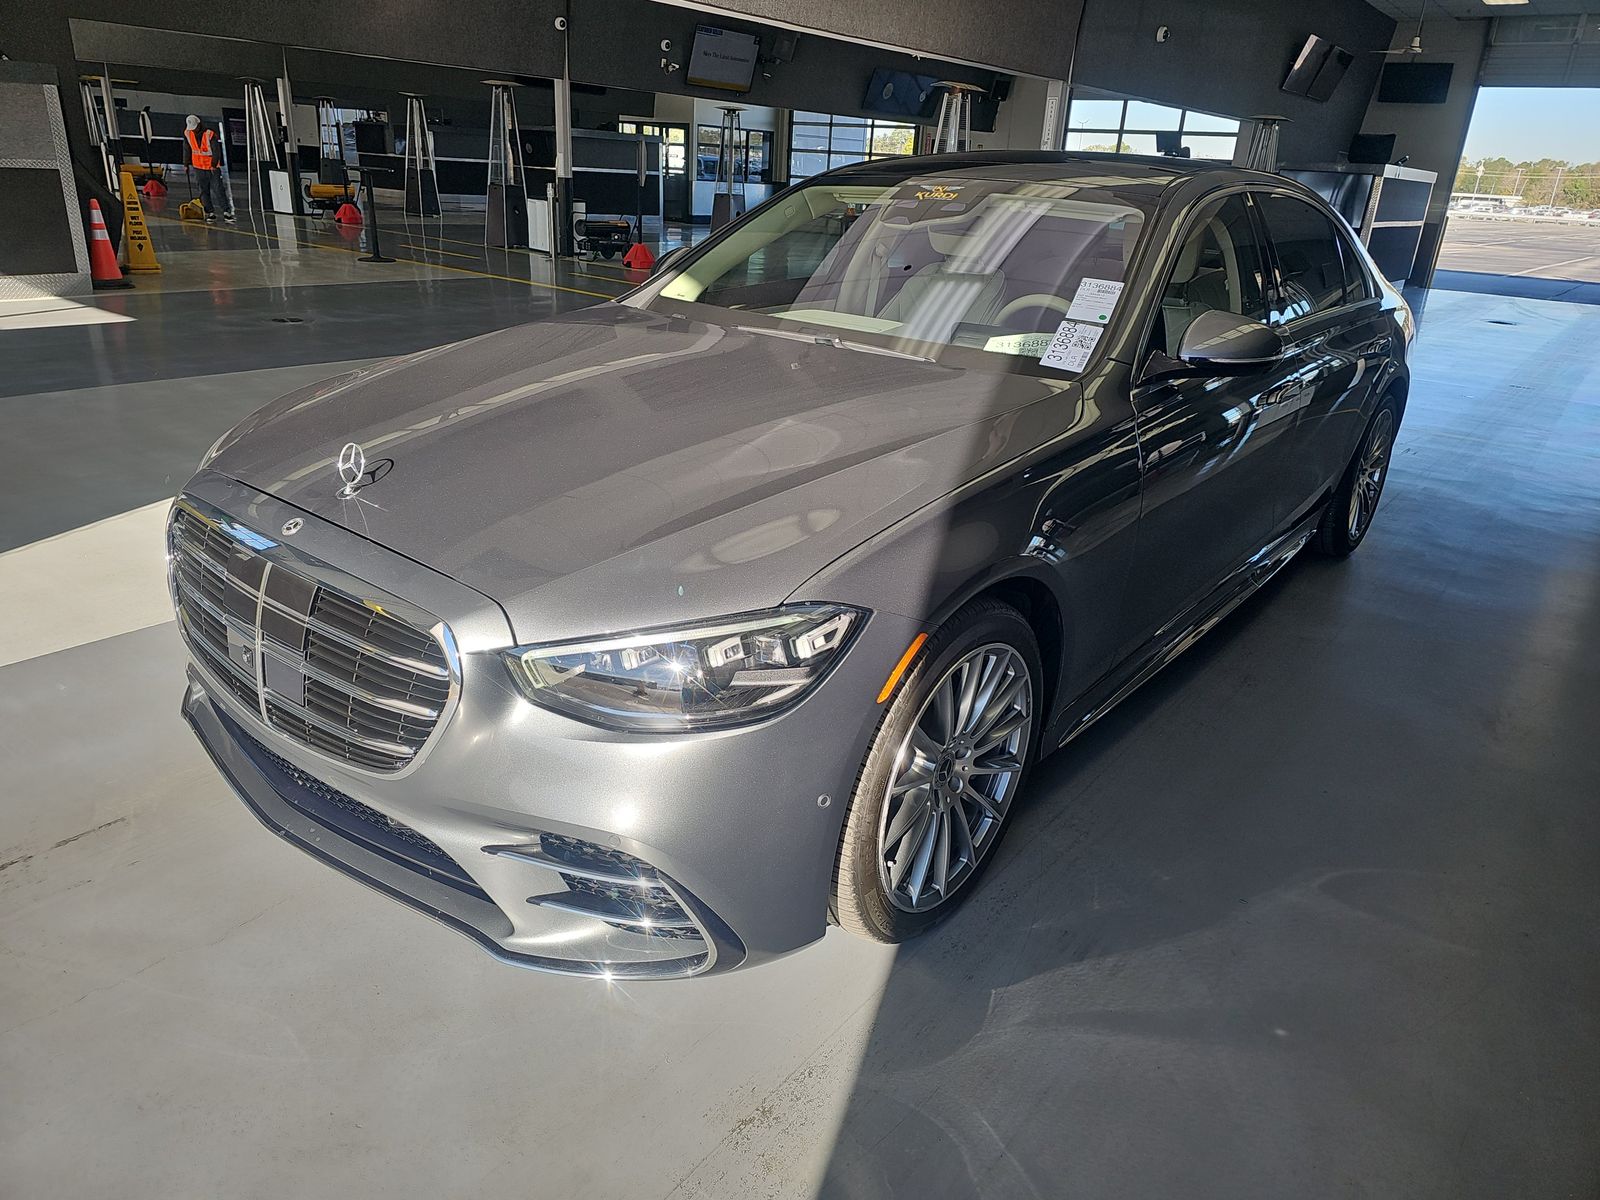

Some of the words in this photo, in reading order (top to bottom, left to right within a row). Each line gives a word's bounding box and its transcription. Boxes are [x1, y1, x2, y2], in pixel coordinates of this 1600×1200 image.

[914, 191, 959, 200] KURDI
[1080, 281, 1122, 292] 3136884
[995, 340, 1051, 349] 313688
[1047, 321, 1077, 361] 3136884
